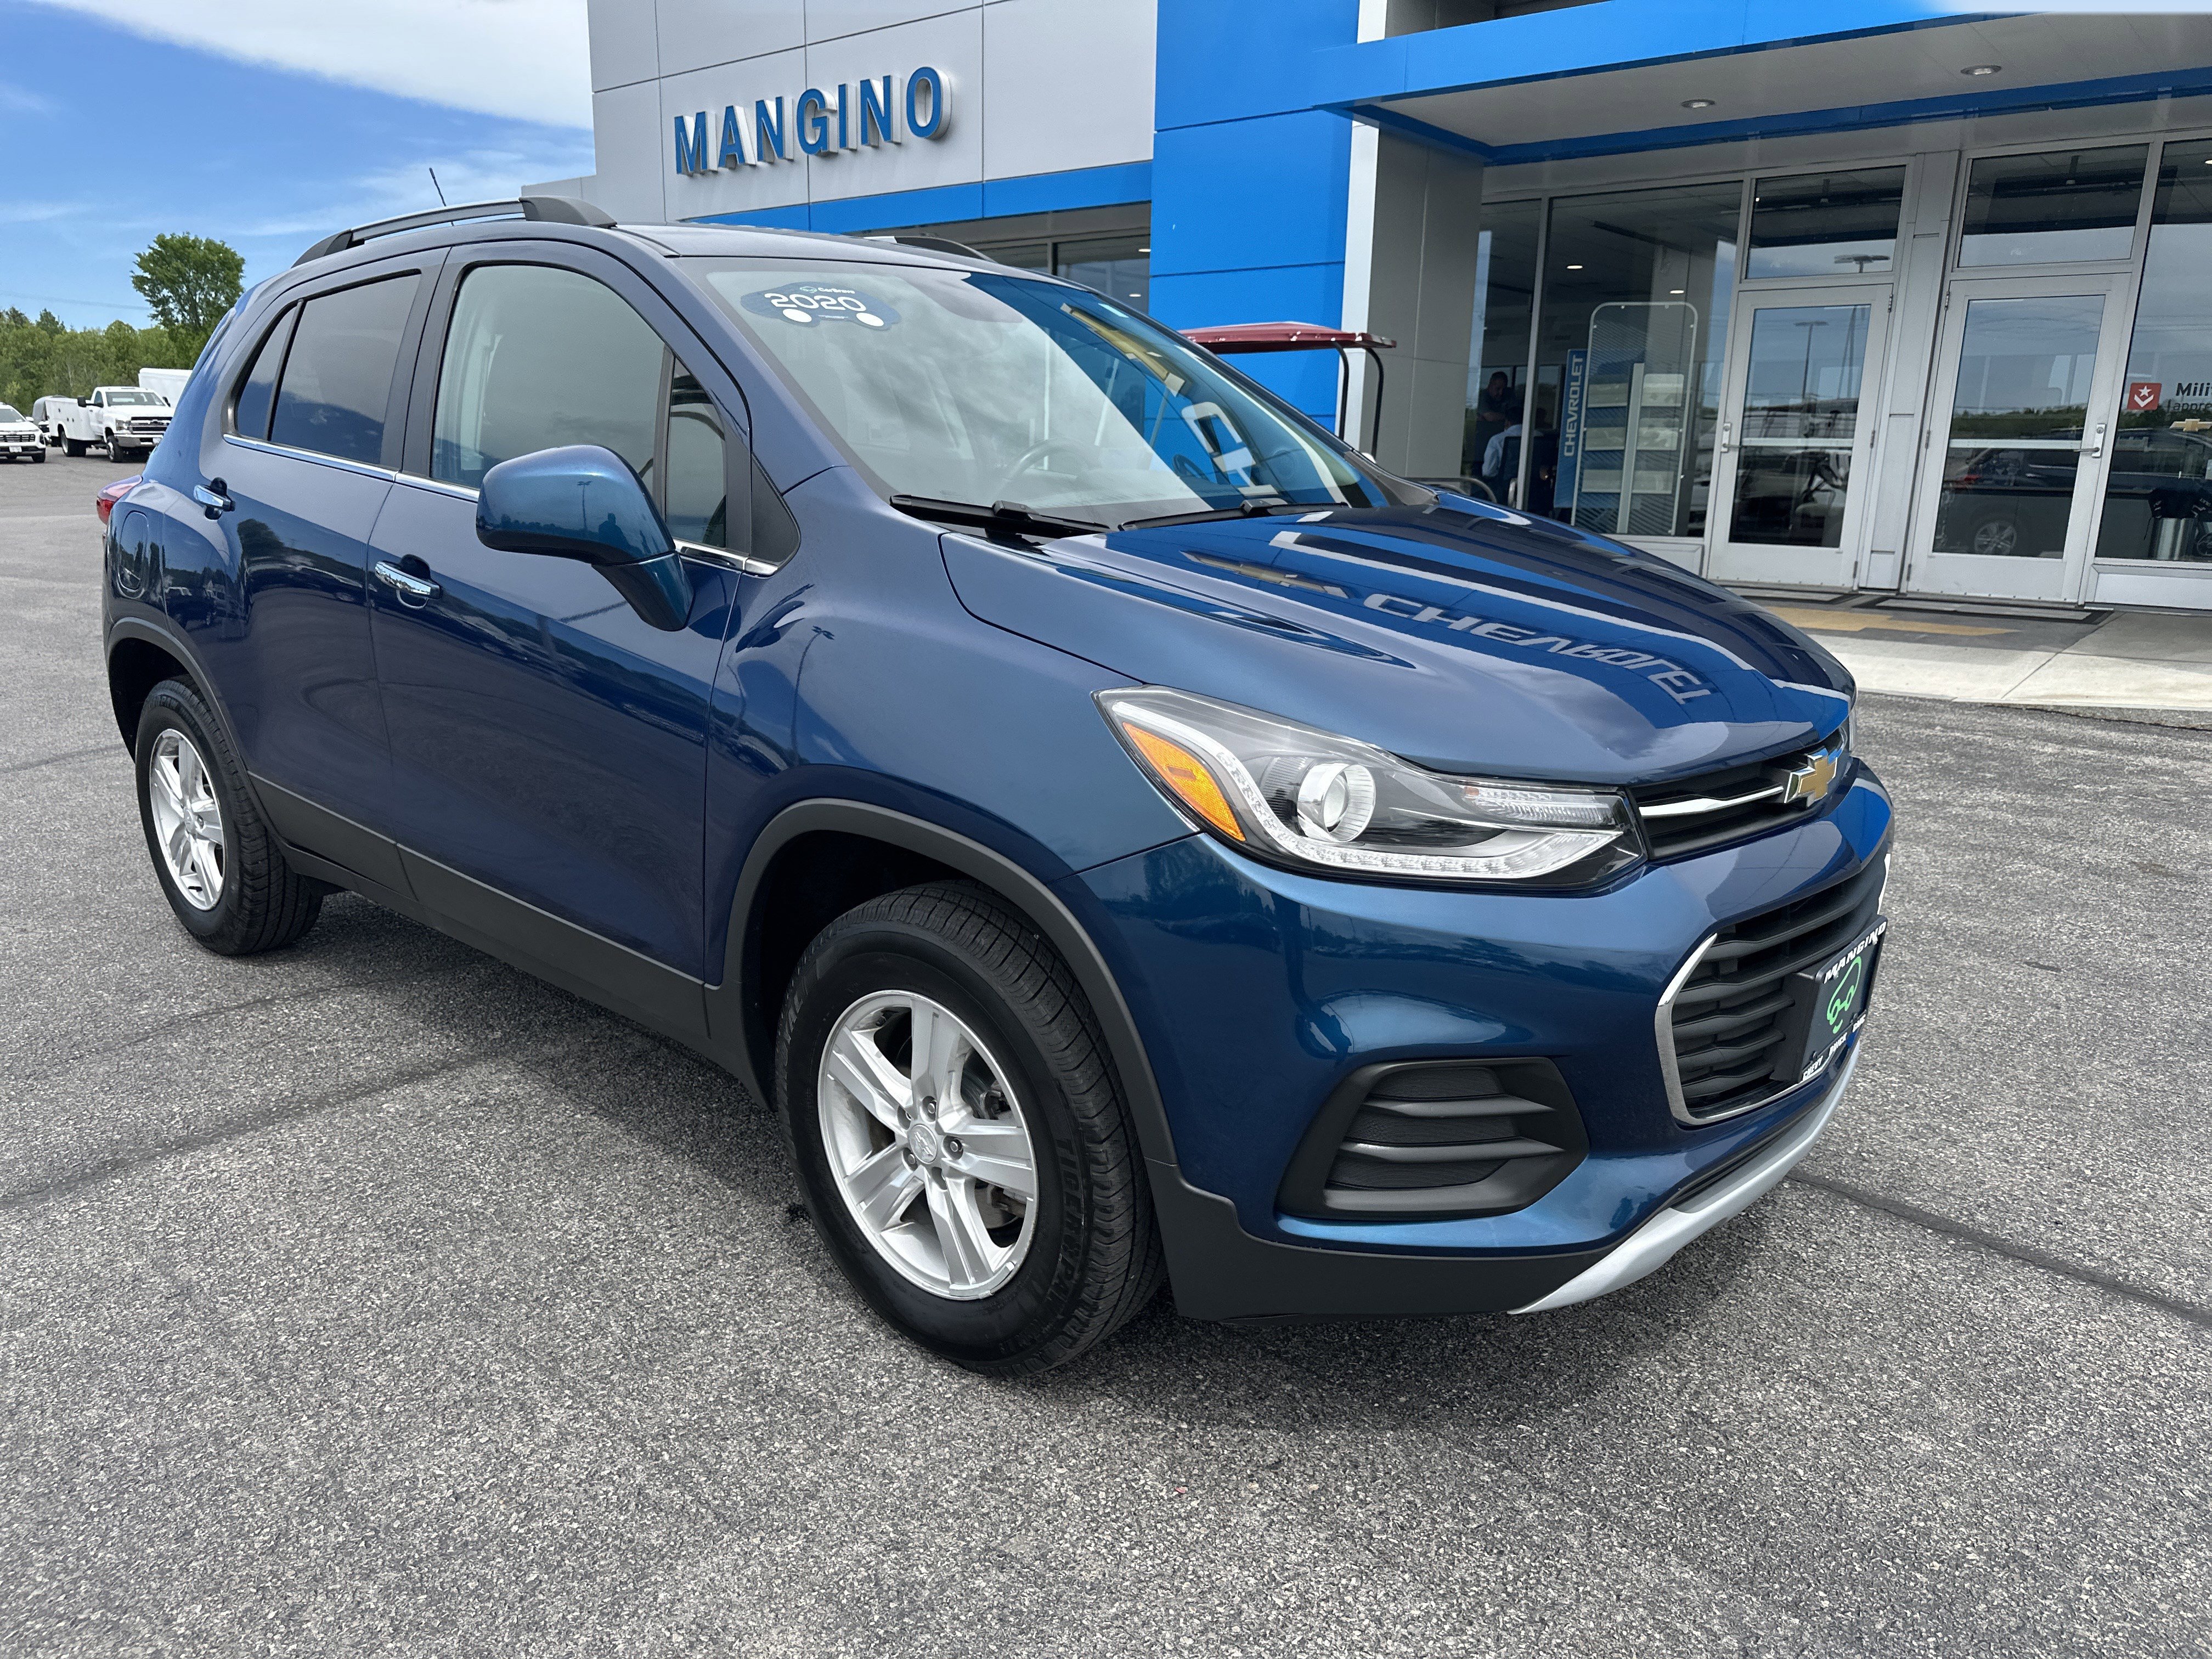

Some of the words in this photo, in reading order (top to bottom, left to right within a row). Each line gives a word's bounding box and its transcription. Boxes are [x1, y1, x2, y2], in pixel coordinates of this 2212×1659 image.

[674, 66, 949, 175] MANGINO
[764, 293, 866, 312] 2020
[1564, 354, 1583, 456] CHEVROLET
[2176, 382, 2212, 396] Mili
[1824, 921, 1886, 984] MANGINO
